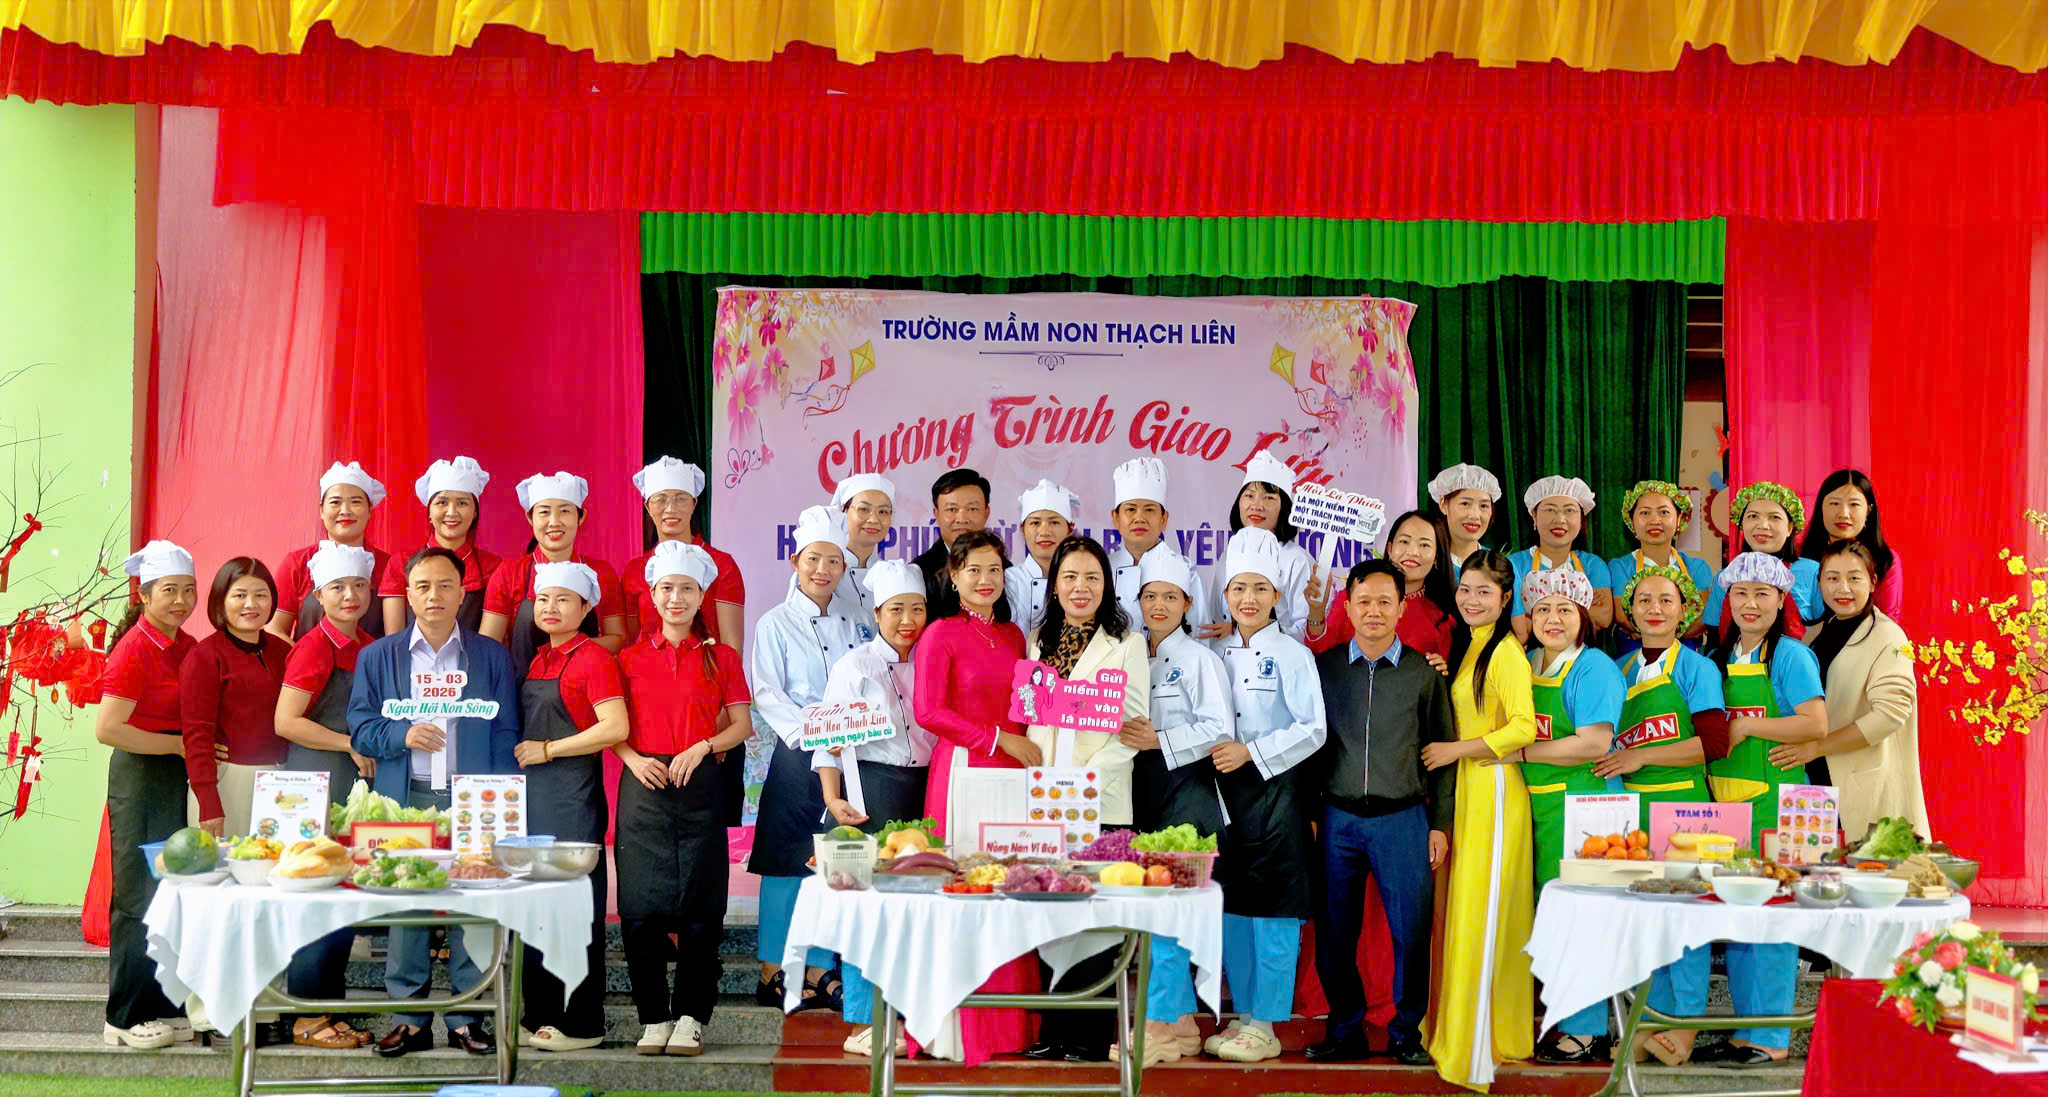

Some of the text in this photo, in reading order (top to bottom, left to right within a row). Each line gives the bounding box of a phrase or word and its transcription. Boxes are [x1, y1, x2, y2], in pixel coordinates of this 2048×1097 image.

[882, 312, 1235, 349] TRƯỜNG MẦM NON THẠCH LIÊN
[818, 412, 975, 495] Chương
[993, 394, 1115, 449] Trình
[1127, 400, 1231, 462] Giao
[1308, 497, 1324, 508] MỘT
[1295, 505, 1310, 517] MỘT
[1333, 513, 1356, 527] NHIỆM
[416, 674, 432, 684] 15
[446, 674, 462, 684] 03
[1100, 673, 1123, 683] Gửi
[423, 687, 456, 697] 2026
[1103, 689, 1121, 699] tin
[387, 702, 493, 716] Ngày Hội Non Sông
[1095, 703, 1119, 714] vào
[1061, 714, 1118, 729] lá phiếu
